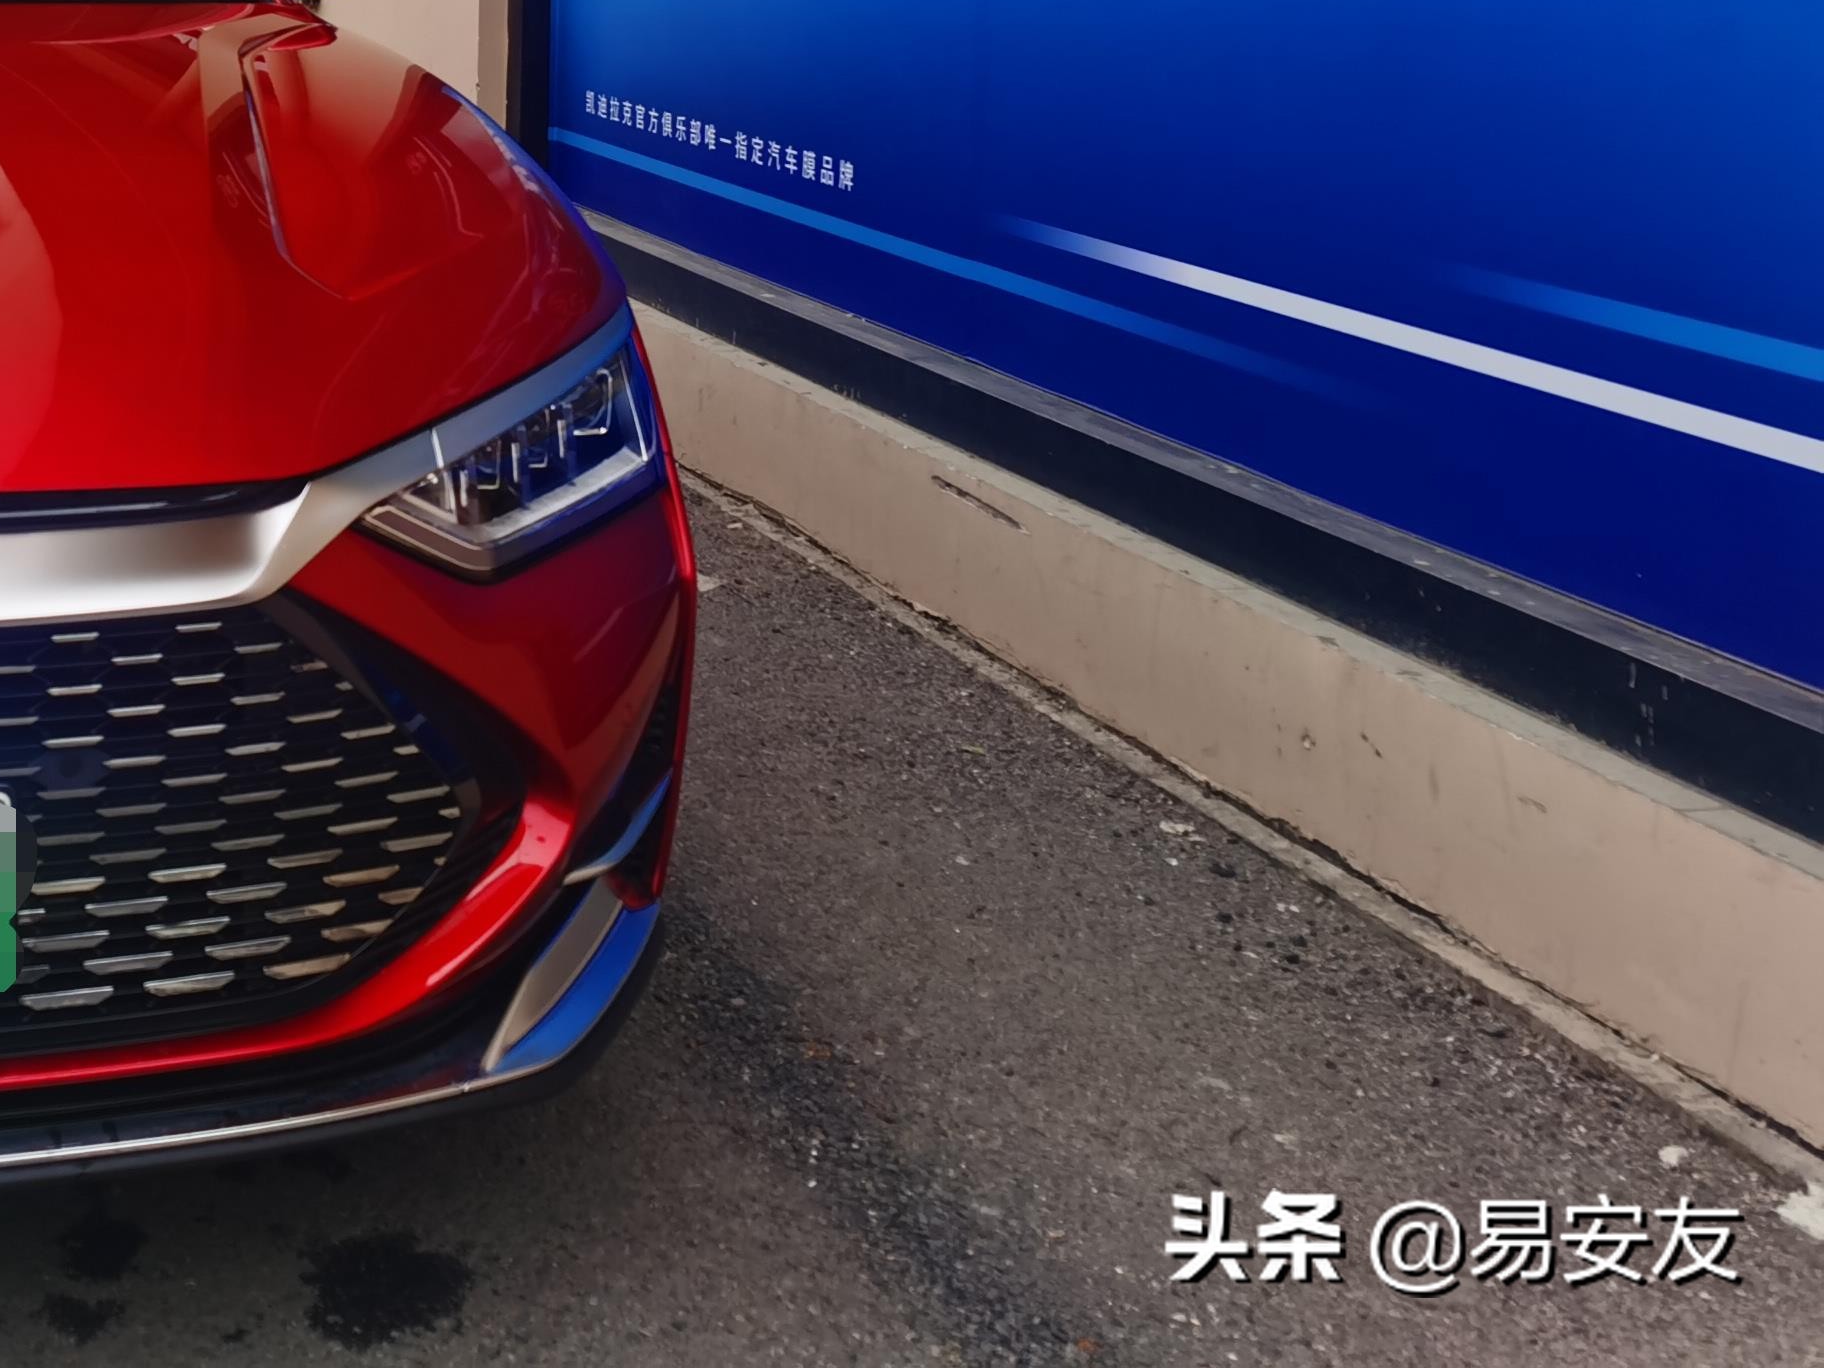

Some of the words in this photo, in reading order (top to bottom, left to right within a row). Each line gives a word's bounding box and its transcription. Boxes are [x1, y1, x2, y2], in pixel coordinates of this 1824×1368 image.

[584, 89, 855, 192] 凯迪拉克官方俱乐部唯一指定汽车膜品牌
